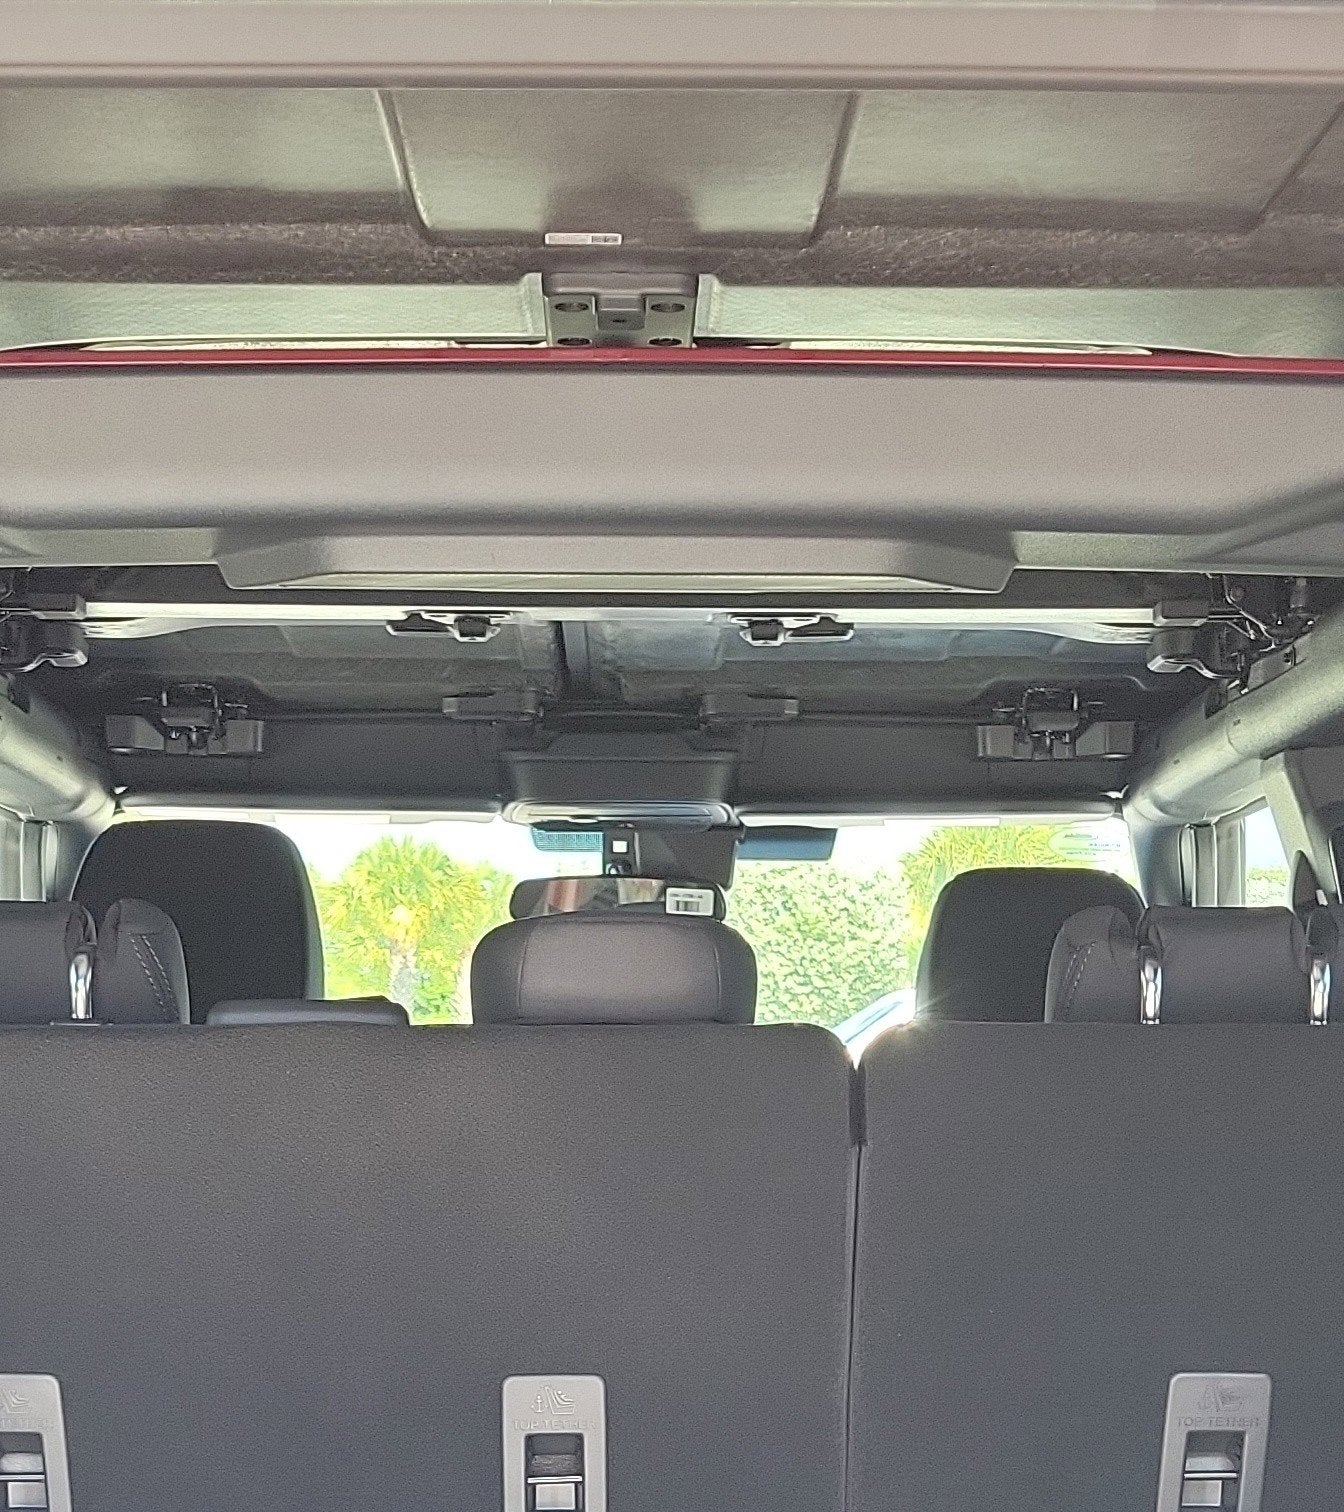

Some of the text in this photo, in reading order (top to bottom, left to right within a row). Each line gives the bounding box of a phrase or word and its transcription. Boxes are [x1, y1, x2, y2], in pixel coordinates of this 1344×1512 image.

[513, 1419, 597, 1431] TOP TETHER
[1177, 1416, 1260, 1428] TOP TETHER
